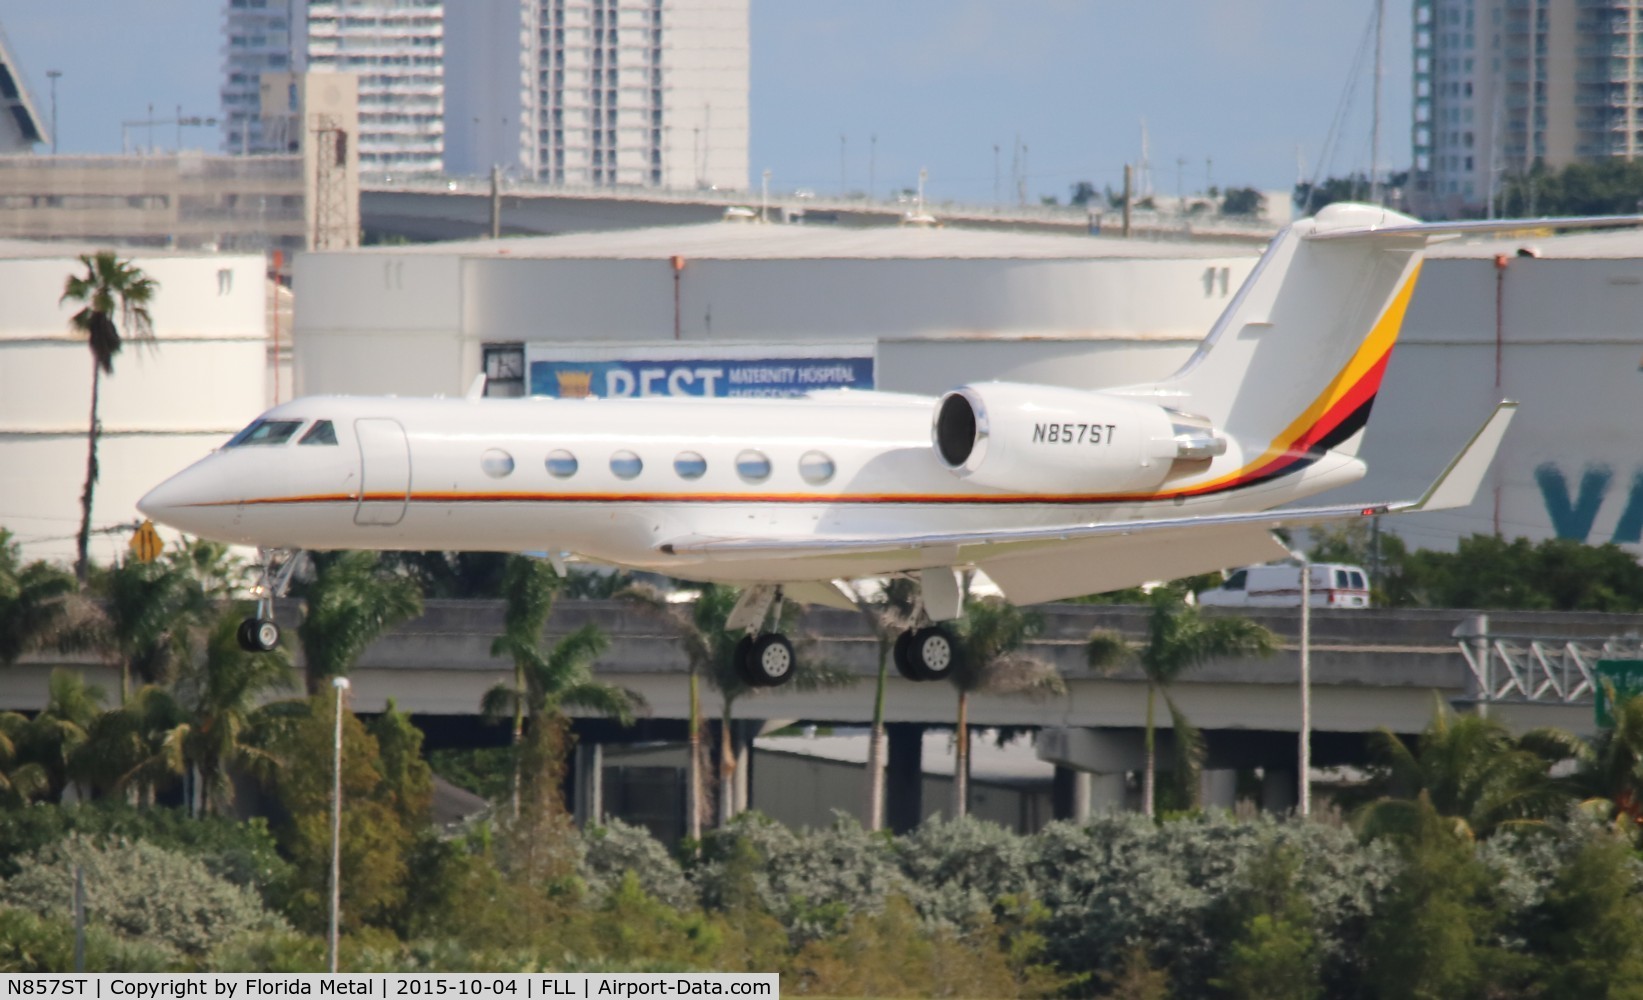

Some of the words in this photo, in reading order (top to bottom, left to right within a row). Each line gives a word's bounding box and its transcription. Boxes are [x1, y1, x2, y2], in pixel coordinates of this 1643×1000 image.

[729, 367, 796, 384] MATERNITY
[798, 365, 855, 383] HOSPITAL
[1032, 423, 1116, 444] N857ST
